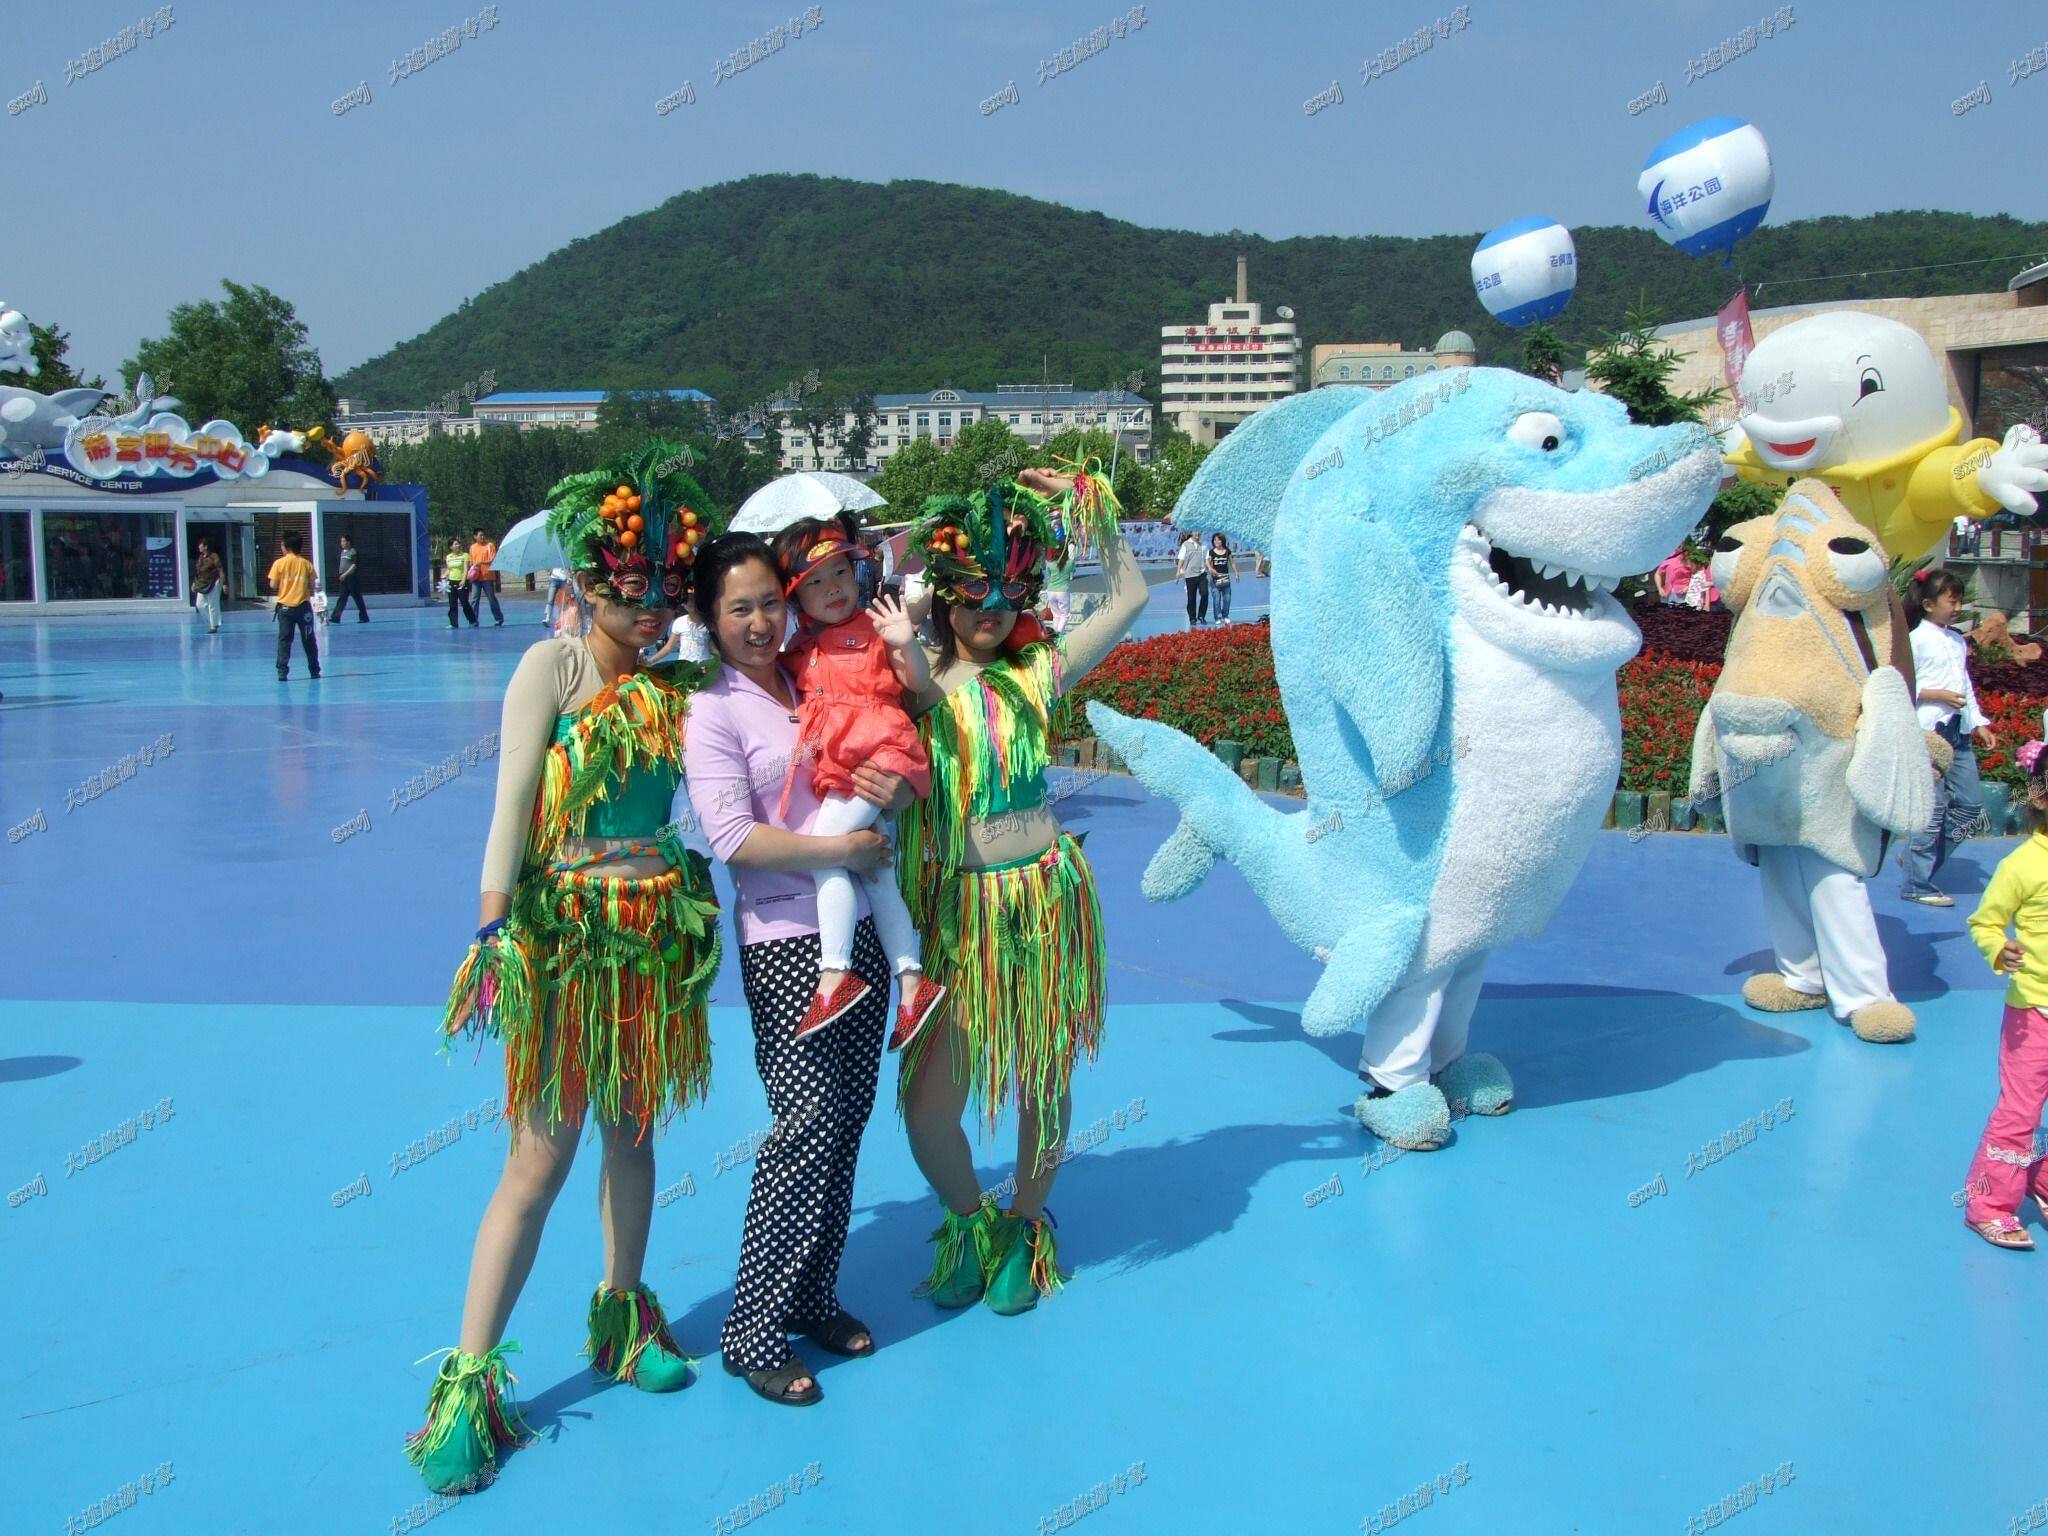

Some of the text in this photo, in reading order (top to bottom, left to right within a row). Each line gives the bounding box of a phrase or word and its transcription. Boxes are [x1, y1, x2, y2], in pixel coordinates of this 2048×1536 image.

[1660, 177, 1722, 216] 海洋公园
[82, 432, 248, 473] 游客服务中心
[46, 464, 94, 487] SERVICE
[100, 479, 144, 491] CENTER
